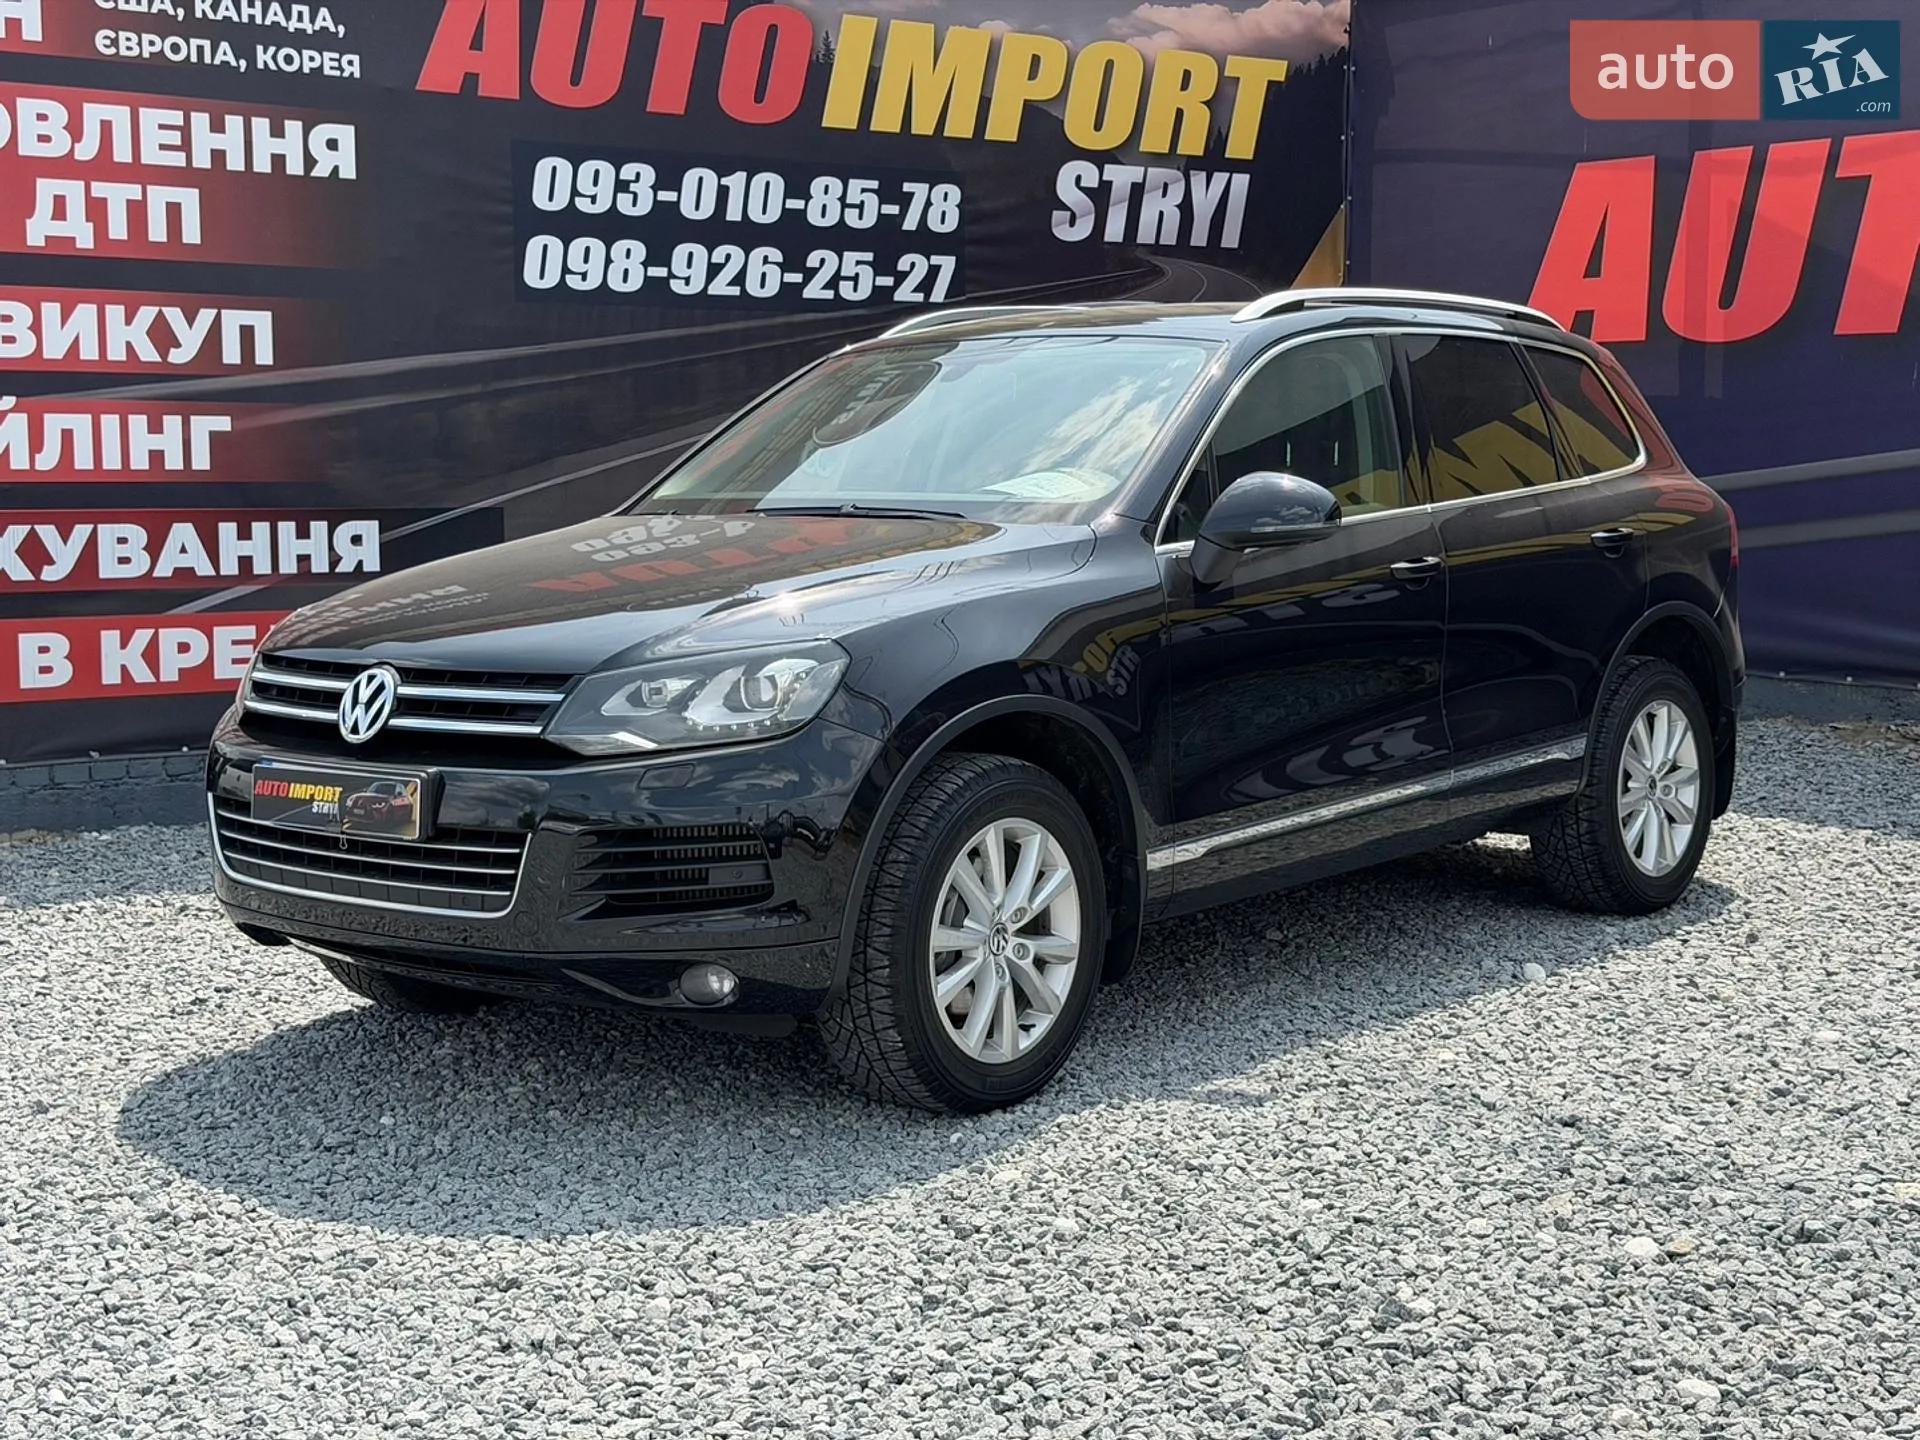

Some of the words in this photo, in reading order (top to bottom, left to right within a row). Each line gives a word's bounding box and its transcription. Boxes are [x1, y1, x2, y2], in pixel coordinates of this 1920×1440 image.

[94, 29, 247, 72] ЄВРОПА,
[255, 45, 361, 78] КОРЕЯ
[194, 0, 346, 38] КАНАДА,
[415, 0, 814, 124] AUTO
[821, 14, 1289, 160] IMPORT
[0, 96, 357, 180] ВЛЕННЯ
[26, 178, 201, 249] ДТП
[532, 156, 962, 233] 093-010-85-78
[1051, 160, 1251, 249] STRYI
[522, 234, 957, 303] 098-926-25-27
[18, 632, 73, 689] В
[101, 625, 258, 684] КРЕ
